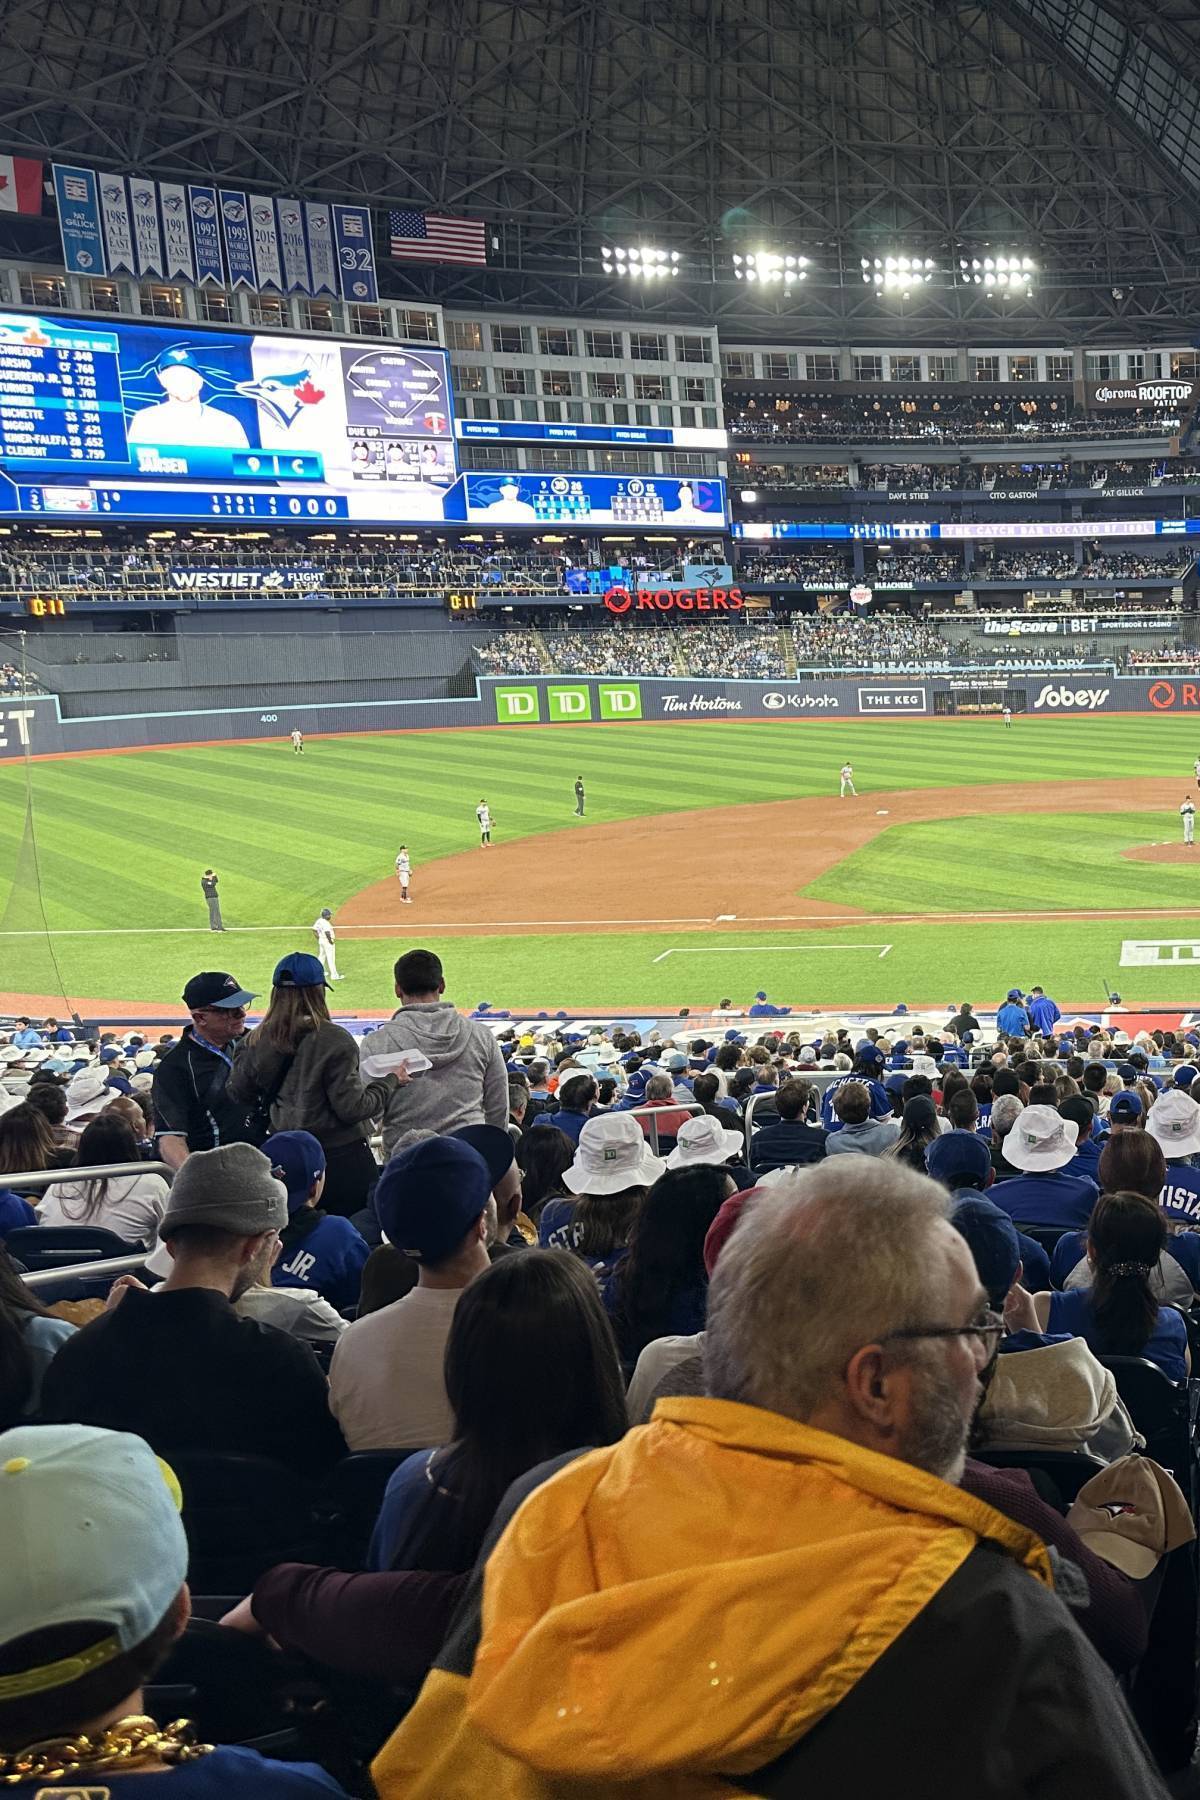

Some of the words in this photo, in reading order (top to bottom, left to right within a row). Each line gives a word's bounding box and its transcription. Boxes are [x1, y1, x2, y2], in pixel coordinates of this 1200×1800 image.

[65, 219, 95, 229] GILLICK
[106, 210, 127, 225] 1985
[135, 214, 156, 229] 1989
[166, 219, 187, 233] 1991
[195, 222, 217, 237] 1992
[227, 225, 248, 241] 1993
[255, 229, 276, 244] 2015
[283, 232, 303, 246] 2016
[109, 237, 129, 249] EAST
[139, 241, 158, 253] EAST
[197, 237, 218, 248] WORLD
[228, 241, 248, 250] WORLD
[168, 246, 188, 258] EAST
[198, 249, 219, 258] SERIES
[230, 252, 250, 261] SERIES
[198, 258, 220, 268] CHAMPS
[340, 247, 373, 272] 32
[1095, 387, 1137, 403] Corona
[1138, 385, 1193, 401] ROOFTOP
[348, 427, 366, 436] DUE
[366, 428, 379, 437] UP
[6, 445, 47, 457] CLEMENT
[405, 443, 417, 453] 27
[292, 459, 304, 474] C
[889, 492, 907, 500] DAVE
[1008, 491, 1038, 499] GASTON
[1101, 489, 1114, 497] PAT
[1116, 489, 1144, 497] GILLICK
[289, 498, 301, 515] 0
[307, 499, 319, 515] 0
[325, 499, 337, 515] 0
[977, 526, 1014, 536] CATCH
[287, 573, 324, 582] FLIGHT
[450, 594, 476, 610] 0:11
[637, 589, 745, 610] ROGERS
[984, 620, 1058, 633] theScore
[1071, 619, 1098, 632] BET
[1102, 621, 1142, 629] SPORTSBOOK
[500, 693, 534, 714] TD
[552, 692, 586, 714] TD
[604, 690, 637, 711] TD
[661, 694, 688, 711] Tim
[788, 694, 839, 707] Kubota
[866, 696, 890, 704] THE
[894, 695, 918, 705] KEG
[1034, 685, 1110, 709] Sobeys
[260, 714, 278, 723] 400
[282, 1250, 316, 1281] JR.
